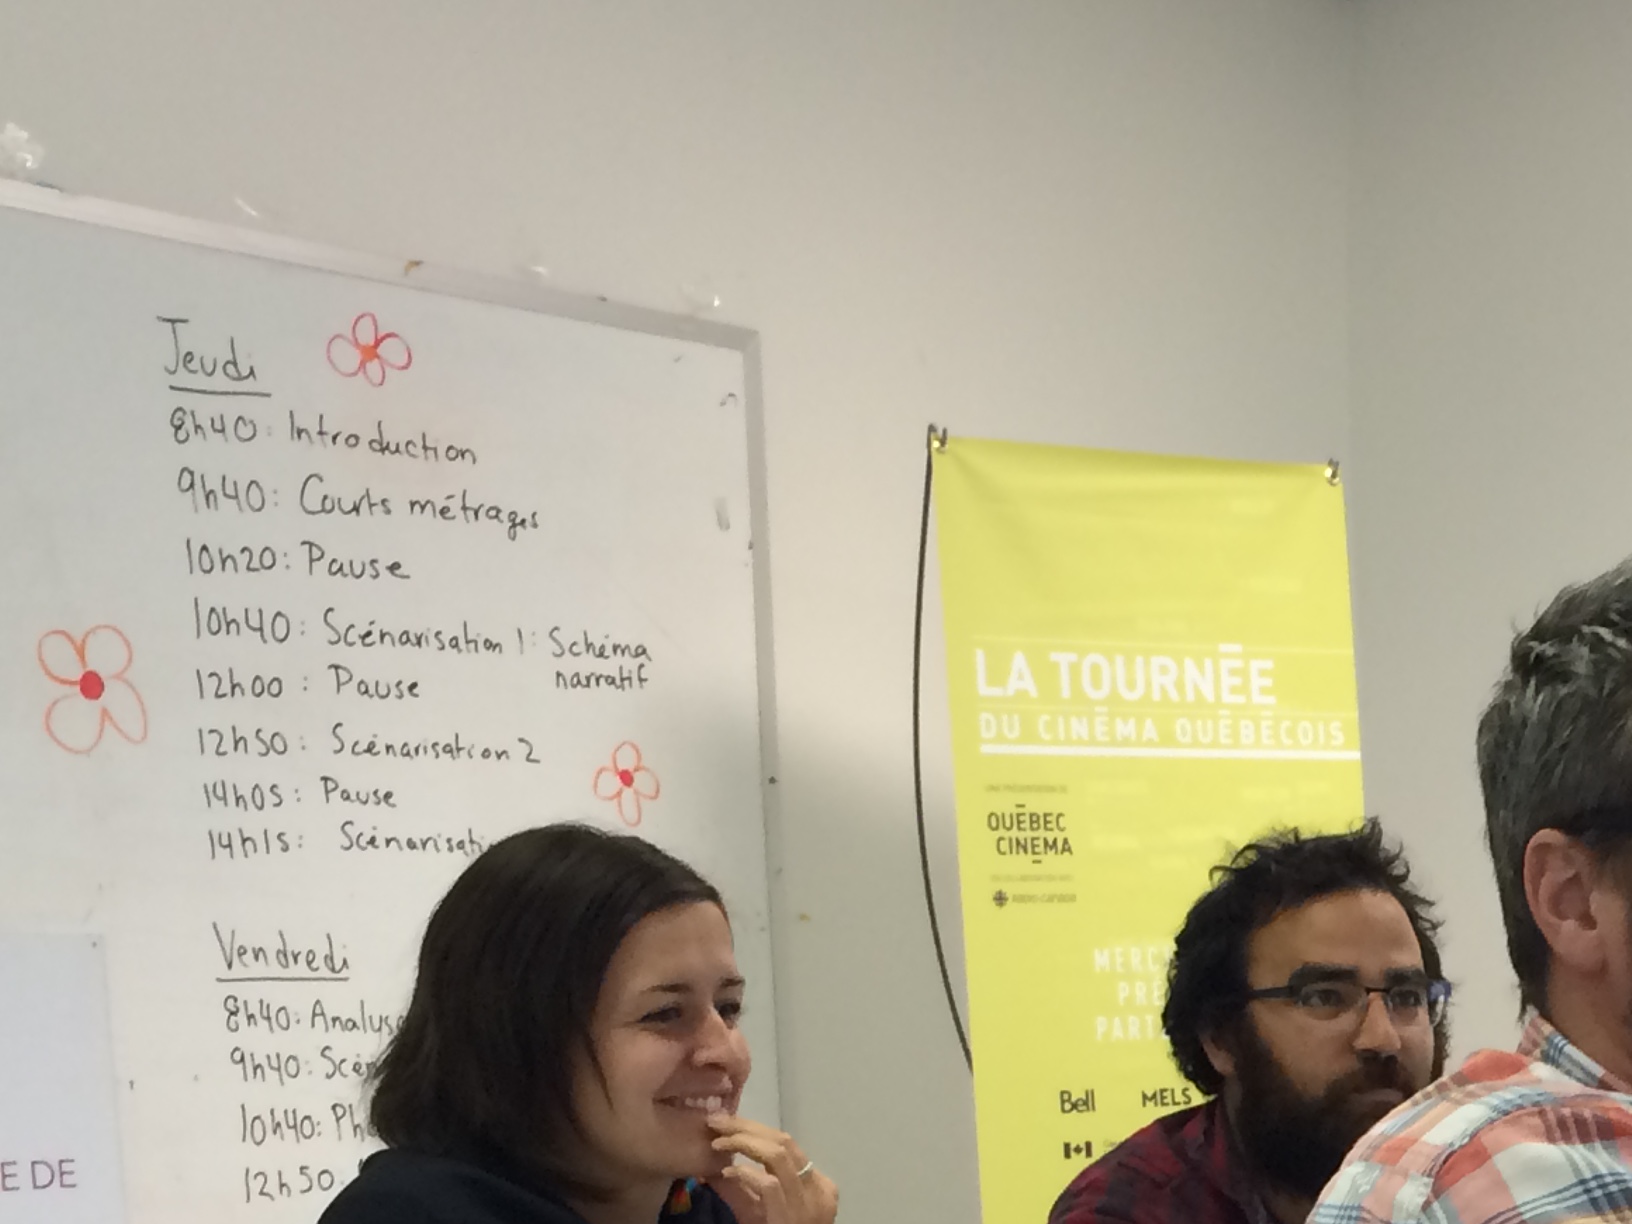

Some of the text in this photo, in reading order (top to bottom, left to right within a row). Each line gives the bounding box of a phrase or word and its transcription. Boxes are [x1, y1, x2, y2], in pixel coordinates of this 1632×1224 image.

[157, 317, 257, 382] Jeudi
[289, 410, 477, 465] Introduction
[300, 473, 392, 517] Courts
[300, 540, 411, 580] Pause
[323, 607, 503, 655] Scénarisation
[327, 664, 420, 700] Pause
[555, 666, 649, 691] narratif
[975, 649, 1038, 698] LA
[979, 711, 1022, 741] DU
[518, 738, 541, 764] 2
[320, 775, 398, 809] Pause
[212, 921, 350, 974] Vendredi
[1059, 1087, 1193, 1114] Bell MELS
[30, 1158, 78, 1190] DE
